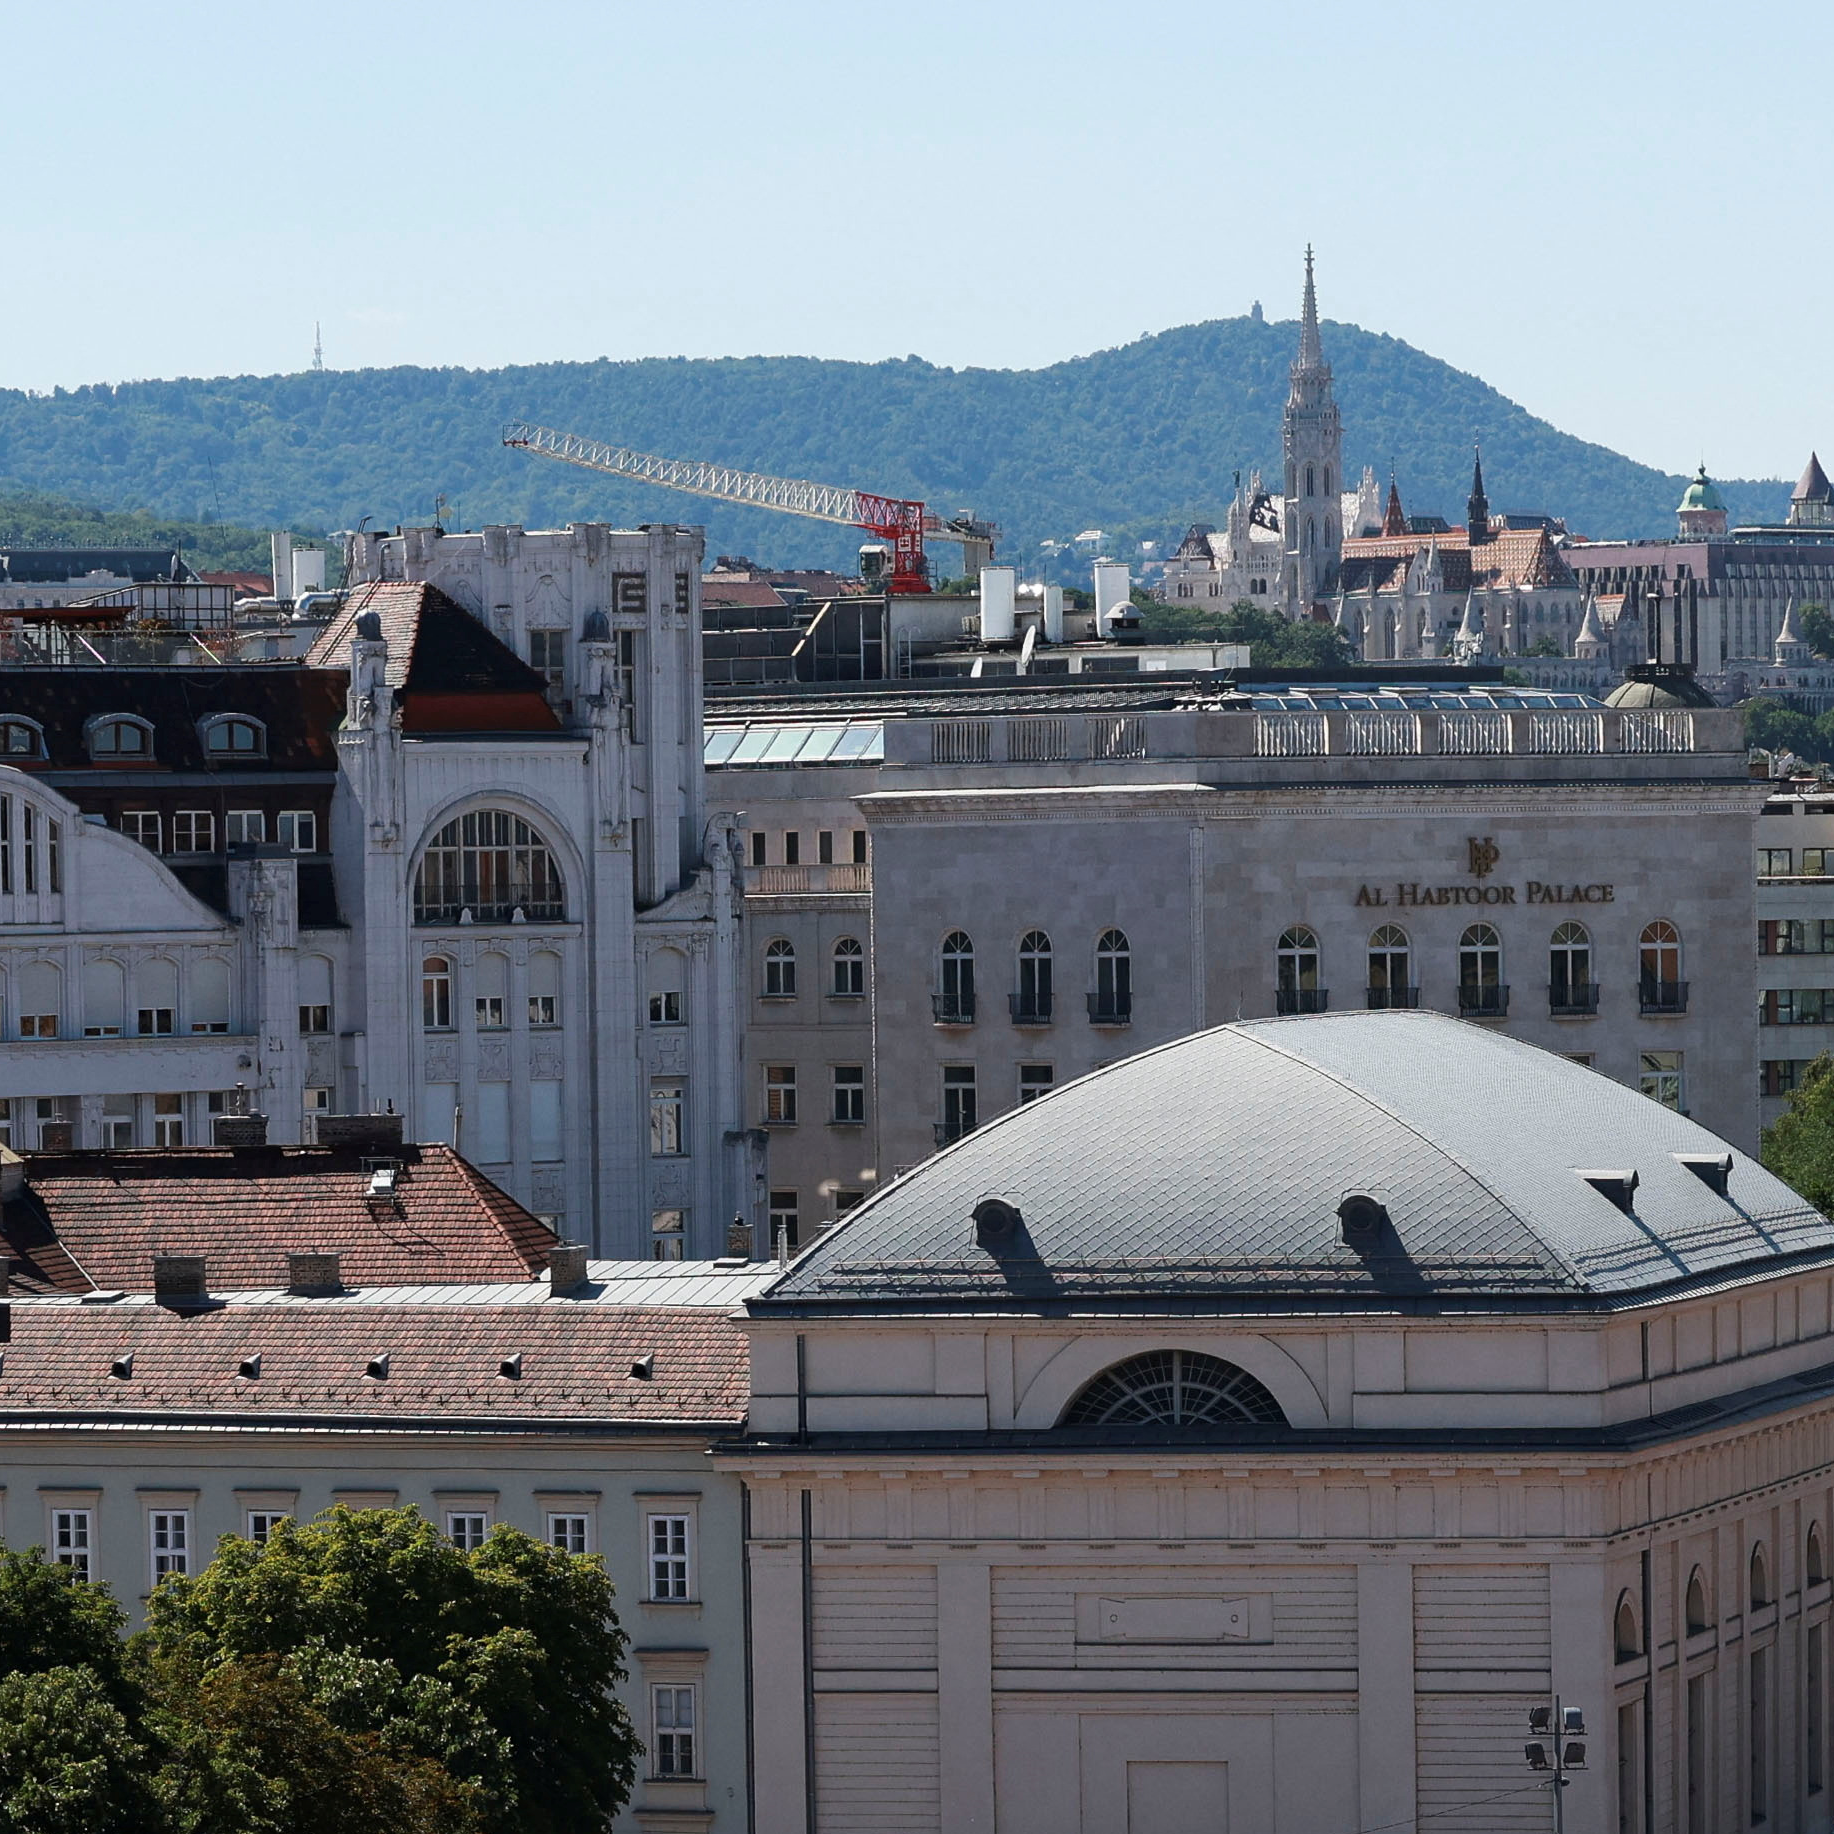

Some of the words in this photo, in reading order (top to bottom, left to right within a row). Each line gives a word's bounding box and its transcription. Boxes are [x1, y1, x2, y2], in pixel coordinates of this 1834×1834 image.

[1355, 884, 1388, 907] AL
[1397, 882, 1517, 906] HABTOOR
[1527, 881, 1615, 904] PALACE
